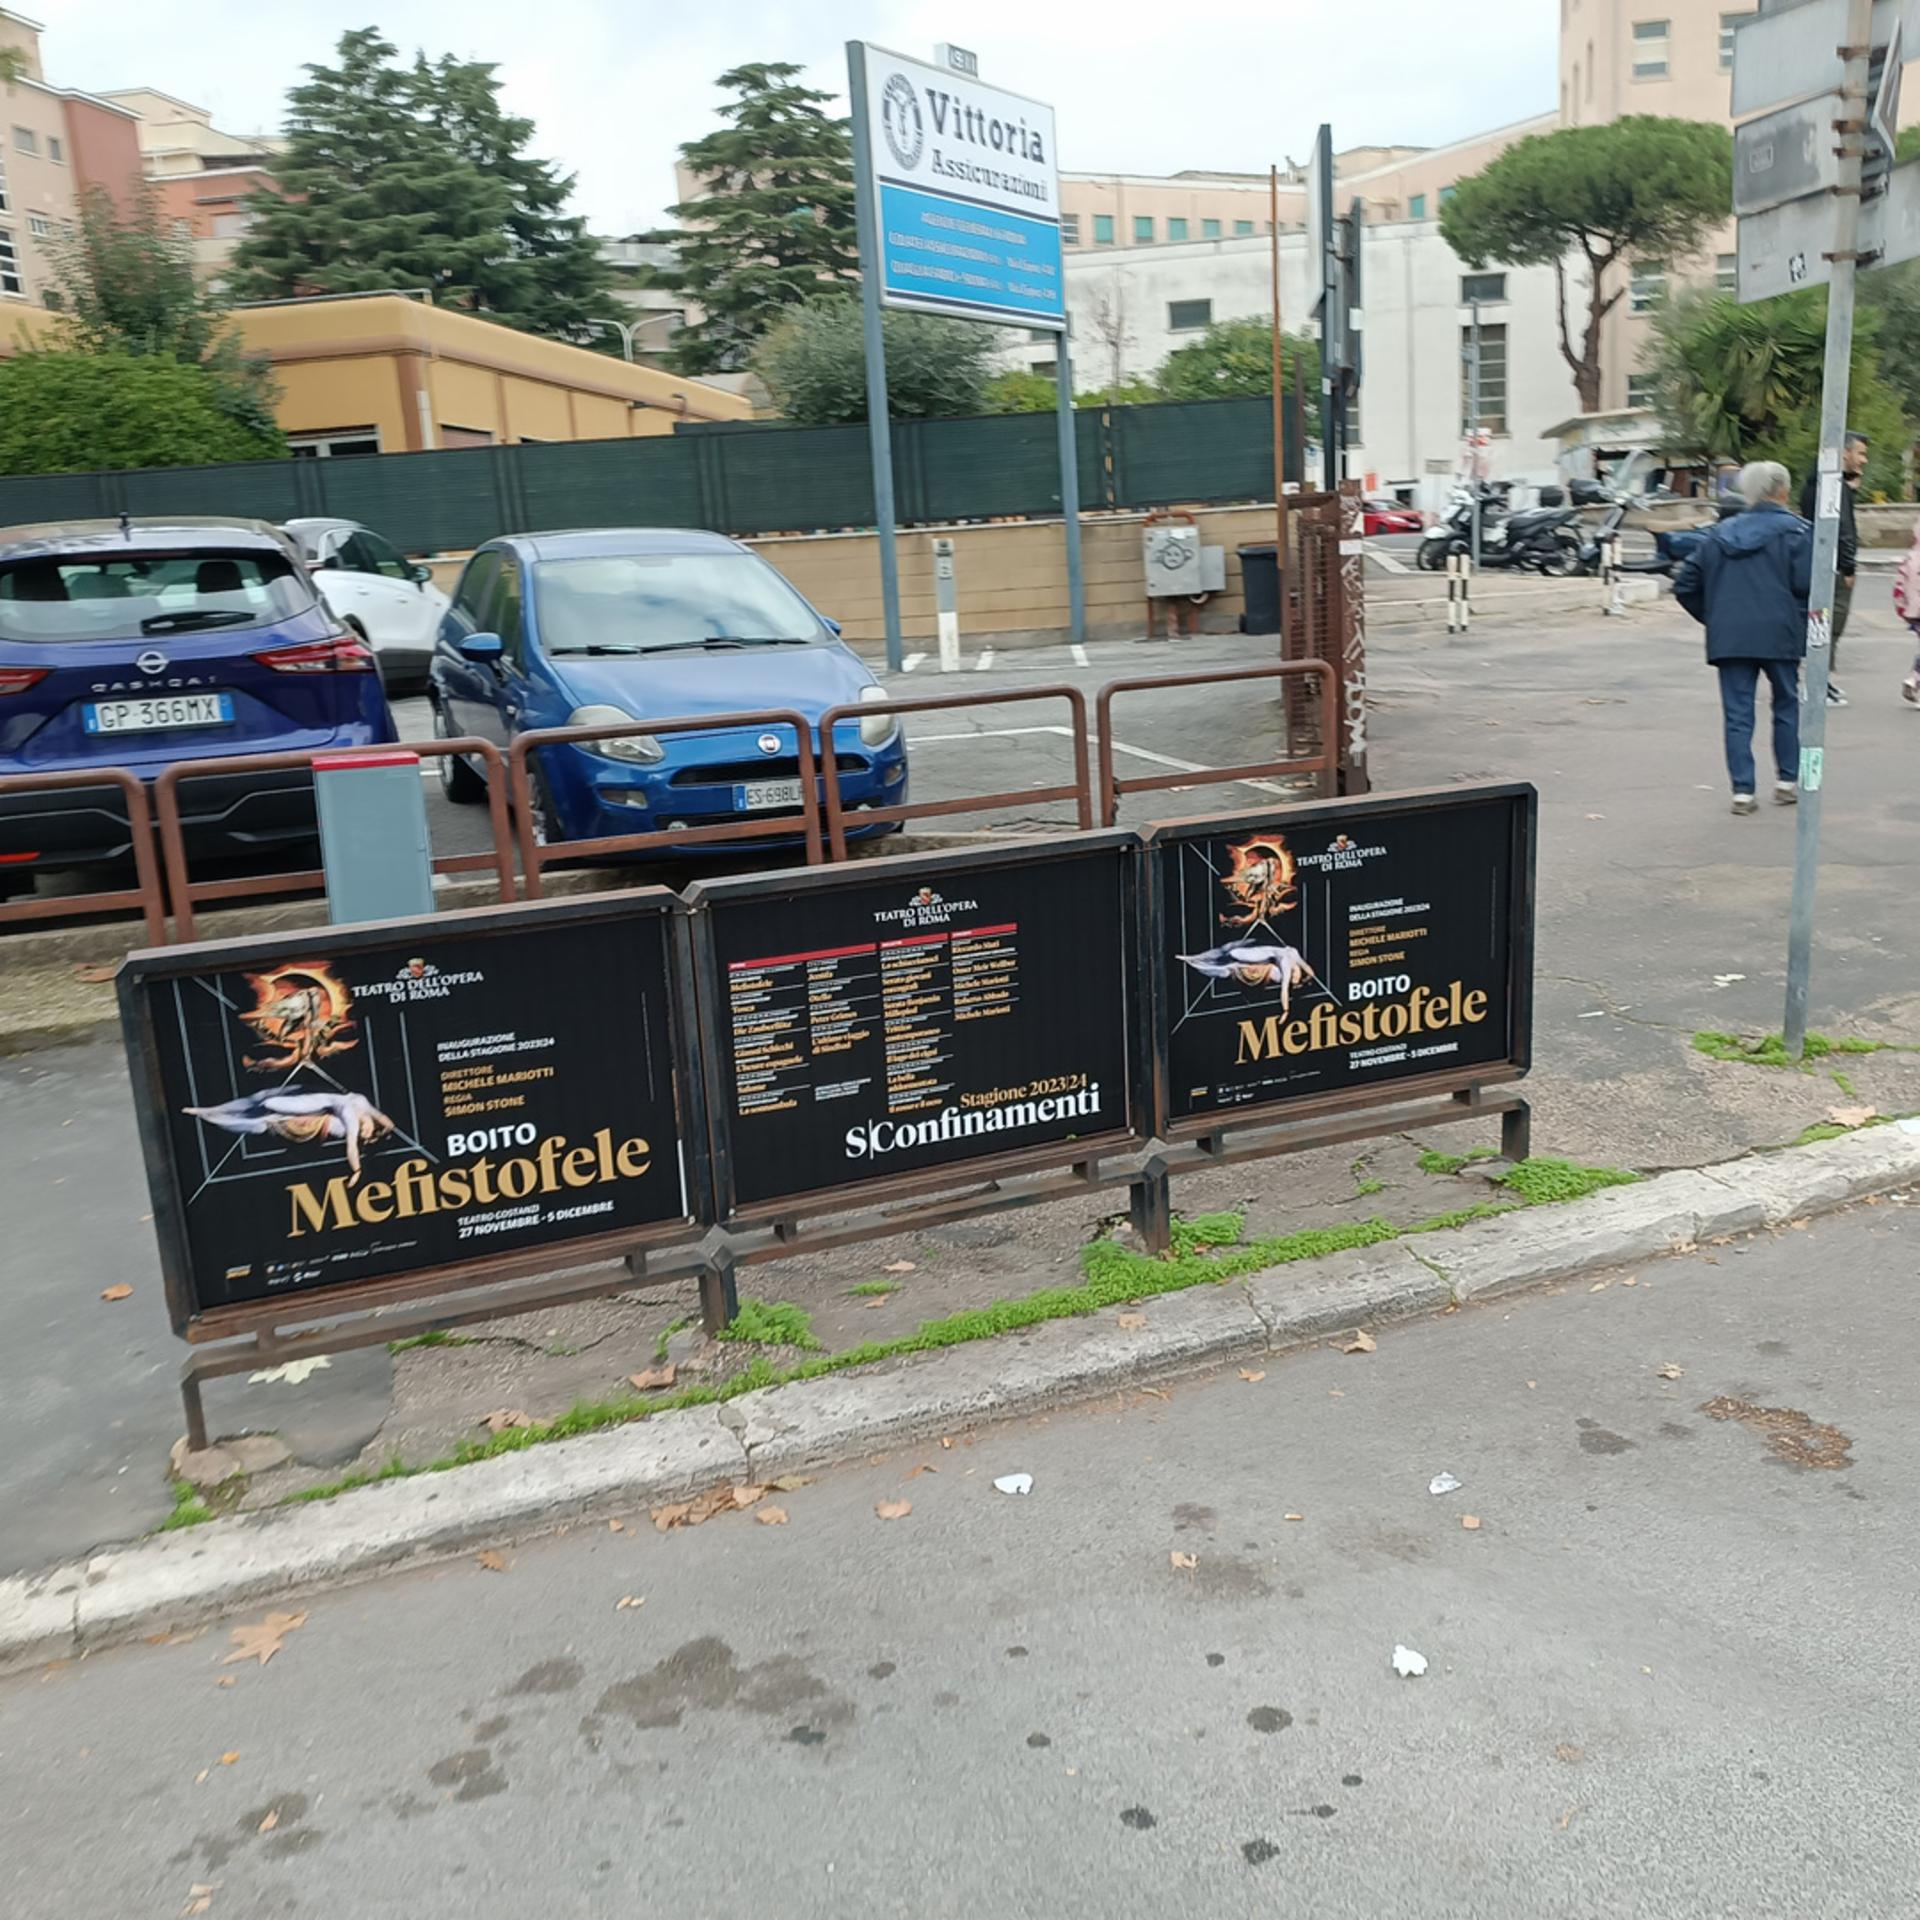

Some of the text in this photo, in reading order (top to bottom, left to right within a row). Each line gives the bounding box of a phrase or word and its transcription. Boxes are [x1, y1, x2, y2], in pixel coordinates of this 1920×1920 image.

[925, 88, 1045, 165] Vittoria
[931, 148, 1048, 202] Assicurazioni
[1296, 846, 1387, 867] TEATRO DELL'OPERA
[1321, 859, 1363, 872] DI ROMA
[873, 900, 979, 922] TEATRO DELL'OPERA
[903, 913, 951, 928] DI ROMA
[351, 971, 484, 998] TEATRO DELL'OPERA
[390, 986, 450, 1004] DI ROMA
[1348, 974, 1411, 1001] BOITO
[1234, 980, 1488, 1065] Mefistofele
[437, 1032, 516, 1052] INAUGURAZIONE
[438, 1049, 470, 1062] DELLA
[470, 1042, 516, 1058] STAGIONE
[1349, 1060, 1360, 1070] 27
[1360, 1052, 1407, 1068] NOVEMBRE
[1416, 1042, 1459, 1057] DICEMBRE
[441, 1064, 494, 1081] DIRETTORE
[442, 1066, 554, 1093] MICHELE MARIOTTI
[444, 1094, 526, 1118] SIMON STONE
[960, 1087, 1027, 1108] Stagione
[447, 1121, 537, 1158] BOITO
[286, 1127, 651, 1239] Mefistofele
[457, 1211, 494, 1226] TEATRO
[458, 1226, 473, 1239] 27
[474, 1213, 541, 1236] NOVEMBRE
[547, 1211, 556, 1223] 5
[556, 1200, 615, 1221] DICEMBRE
